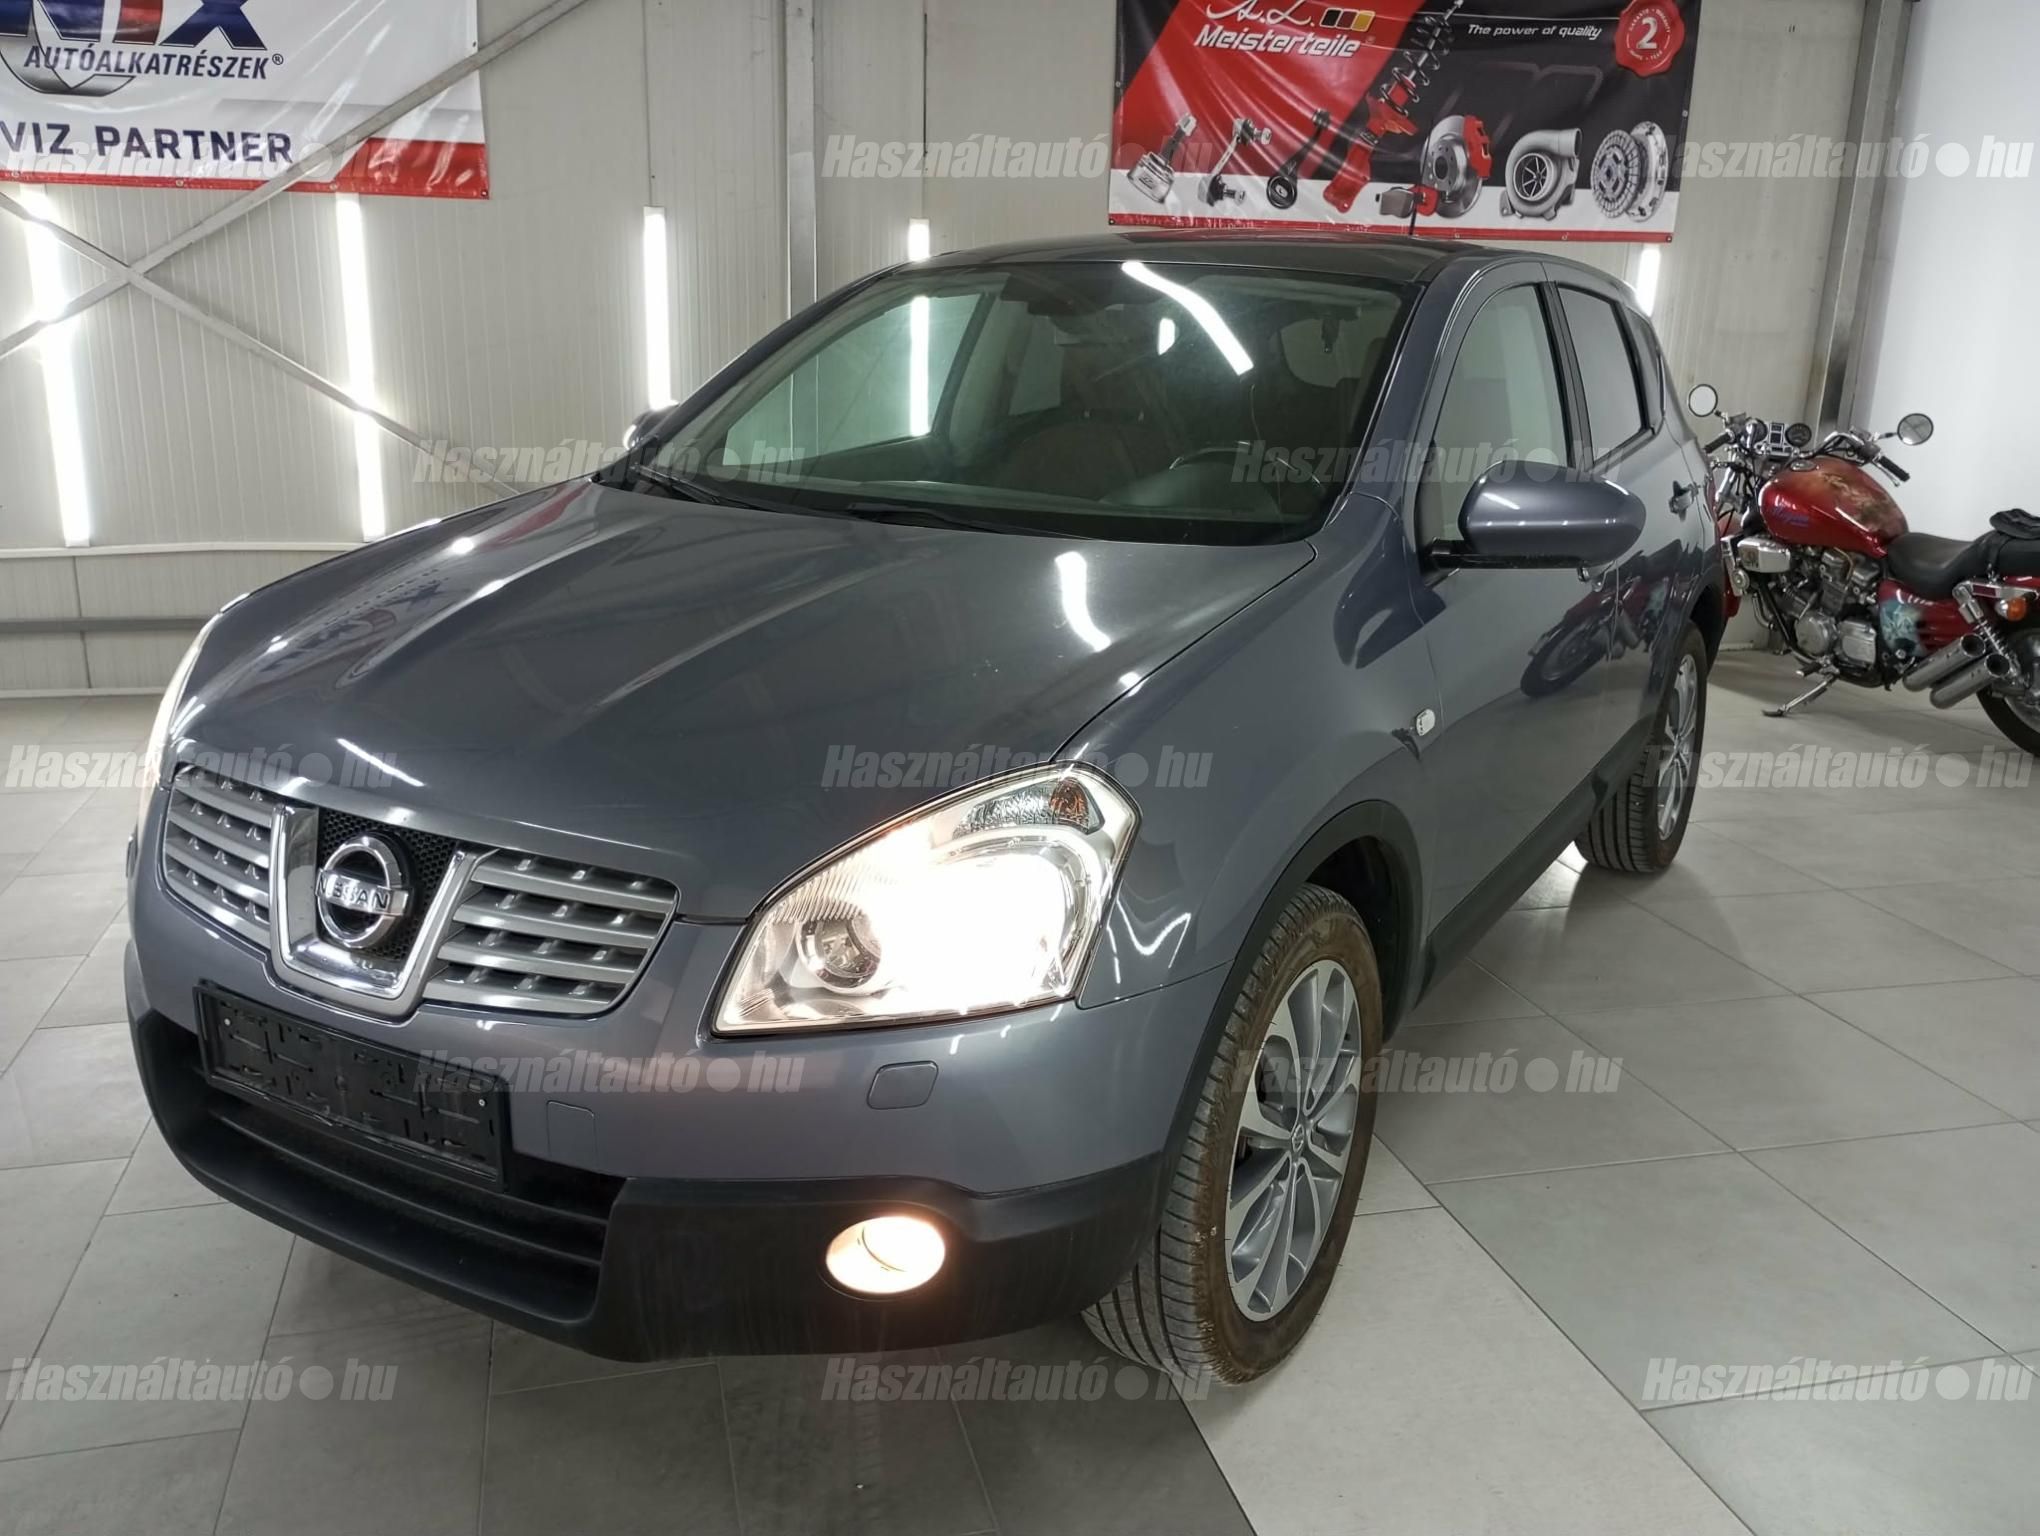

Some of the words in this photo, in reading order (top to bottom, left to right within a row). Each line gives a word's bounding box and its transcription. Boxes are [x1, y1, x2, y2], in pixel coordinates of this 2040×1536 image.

[1194, 24, 1361, 58] Meisterteile
[1468, 24, 1490, 35] The
[1493, 27, 1538, 37] power
[1541, 26, 1556, 36] of
[1559, 25, 1602, 41] quality
[1636, 16, 1658, 50] 2
[0, 121, 74, 155] VIZ
[95, 125, 293, 164] PARTNER
